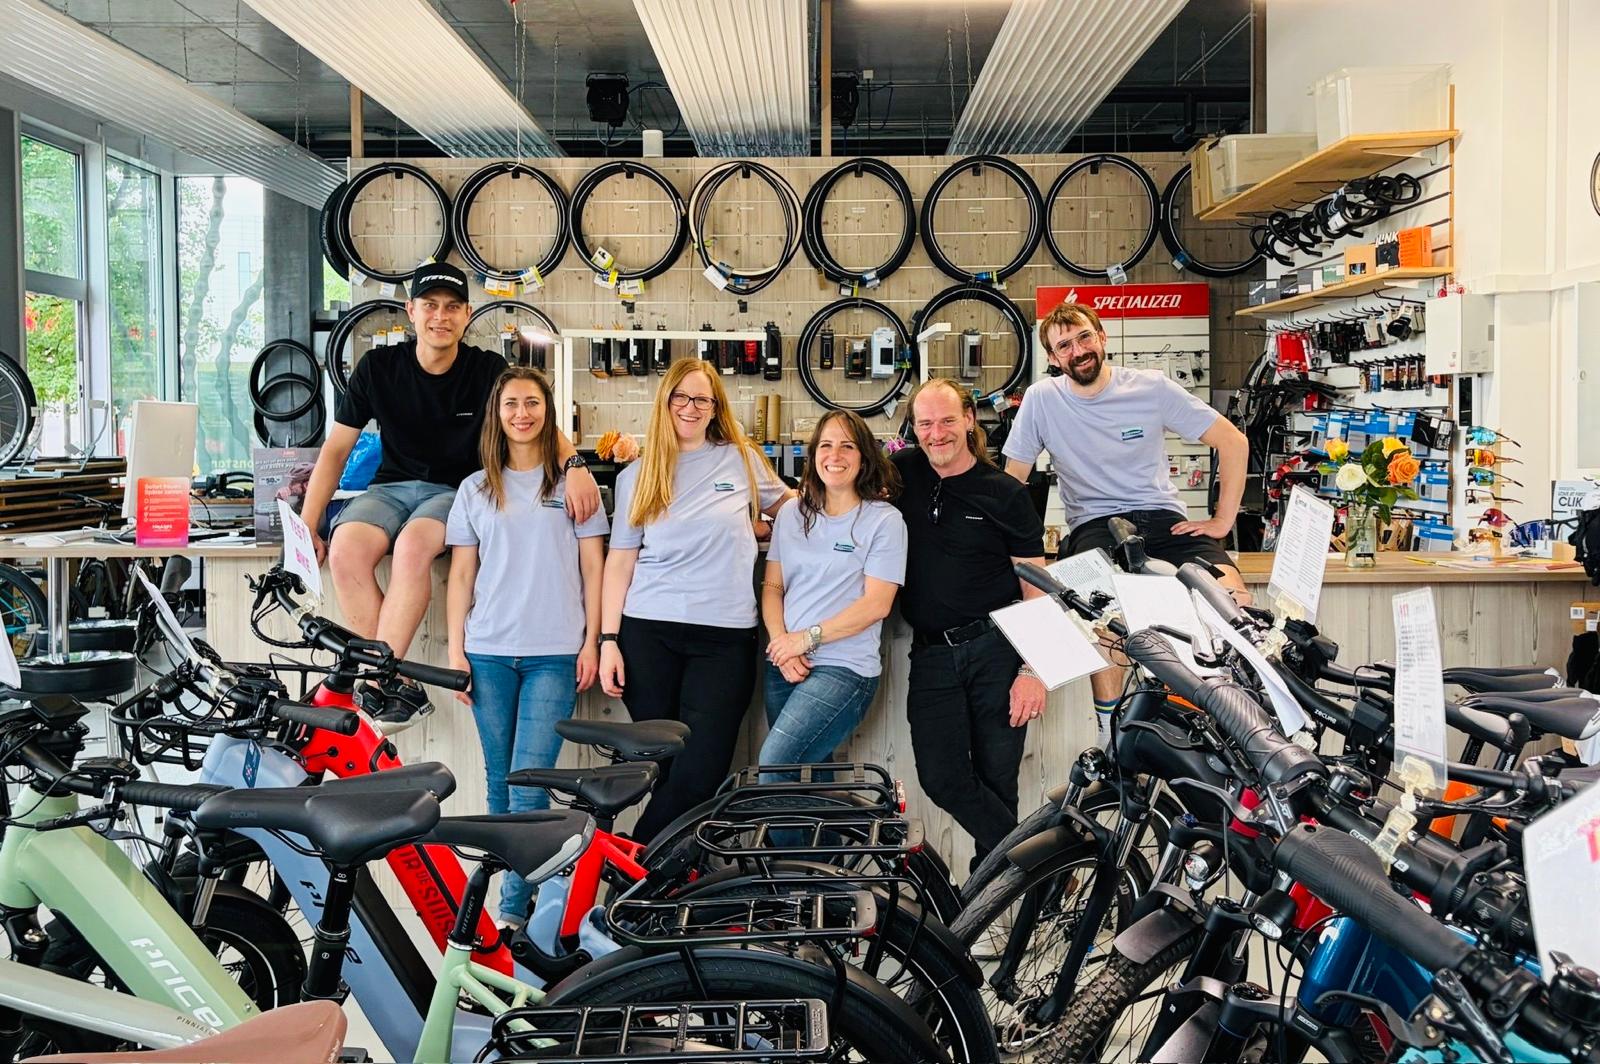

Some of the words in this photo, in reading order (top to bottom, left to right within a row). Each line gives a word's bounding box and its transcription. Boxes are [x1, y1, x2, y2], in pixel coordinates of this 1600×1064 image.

[419, 274, 464, 286] STEVENS
[1091, 294, 1182, 310] SPECIALIZED
[1558, 496, 1584, 507] CLIK
[461, 895, 475, 934] RITCHEY
